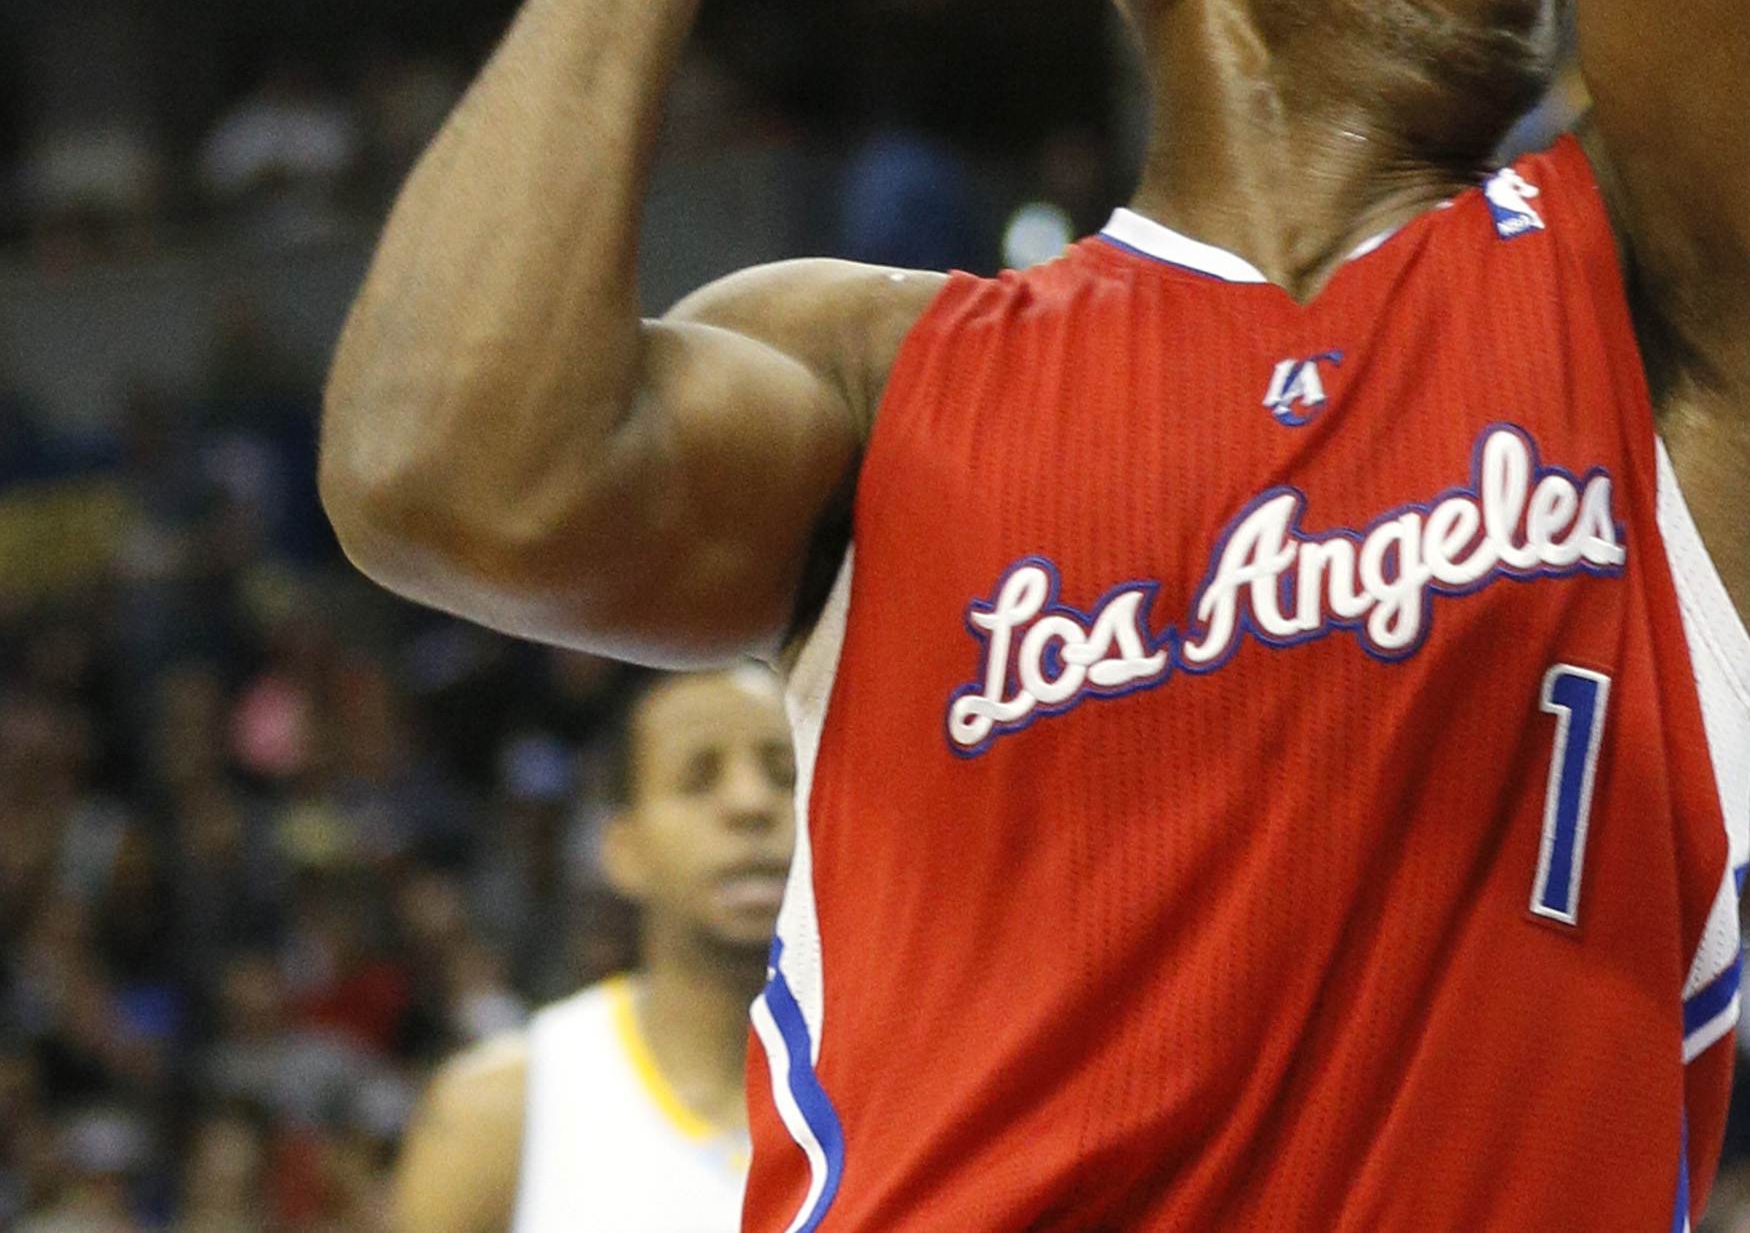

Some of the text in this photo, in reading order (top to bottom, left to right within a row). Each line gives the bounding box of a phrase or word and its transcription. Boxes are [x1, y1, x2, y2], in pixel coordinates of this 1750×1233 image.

[946, 423, 1626, 758] Los Angeles
[1530, 664, 1611, 927] 1
